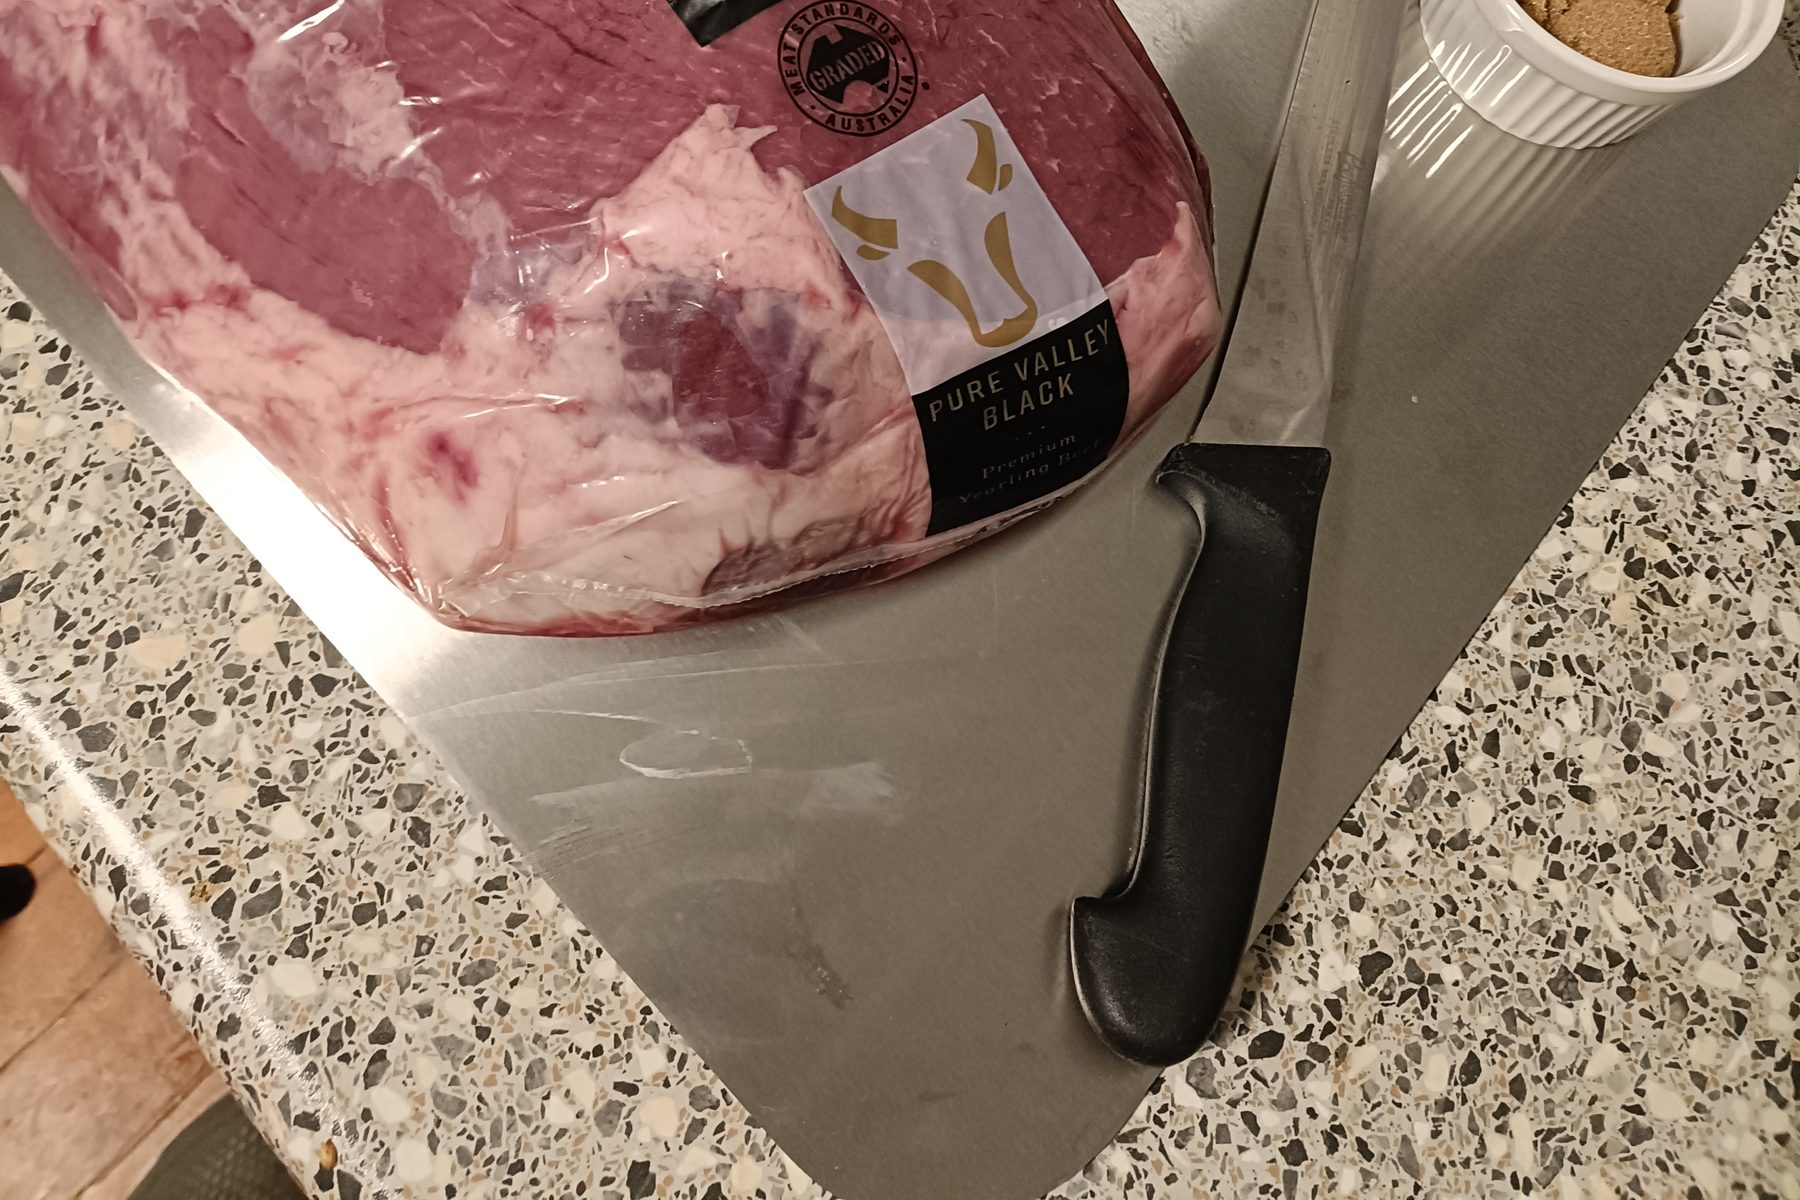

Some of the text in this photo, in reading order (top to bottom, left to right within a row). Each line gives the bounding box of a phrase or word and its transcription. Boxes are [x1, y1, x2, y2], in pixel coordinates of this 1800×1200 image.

[783, 3, 900, 97] MEAT STANDARDS
[809, 41, 886, 91] GRADED
[825, 75, 914, 132] AUSTRALIA
[929, 319, 1110, 423] PURE VALLEY
[983, 373, 1075, 431] BLACK
[981, 434, 1076, 479] Premium
